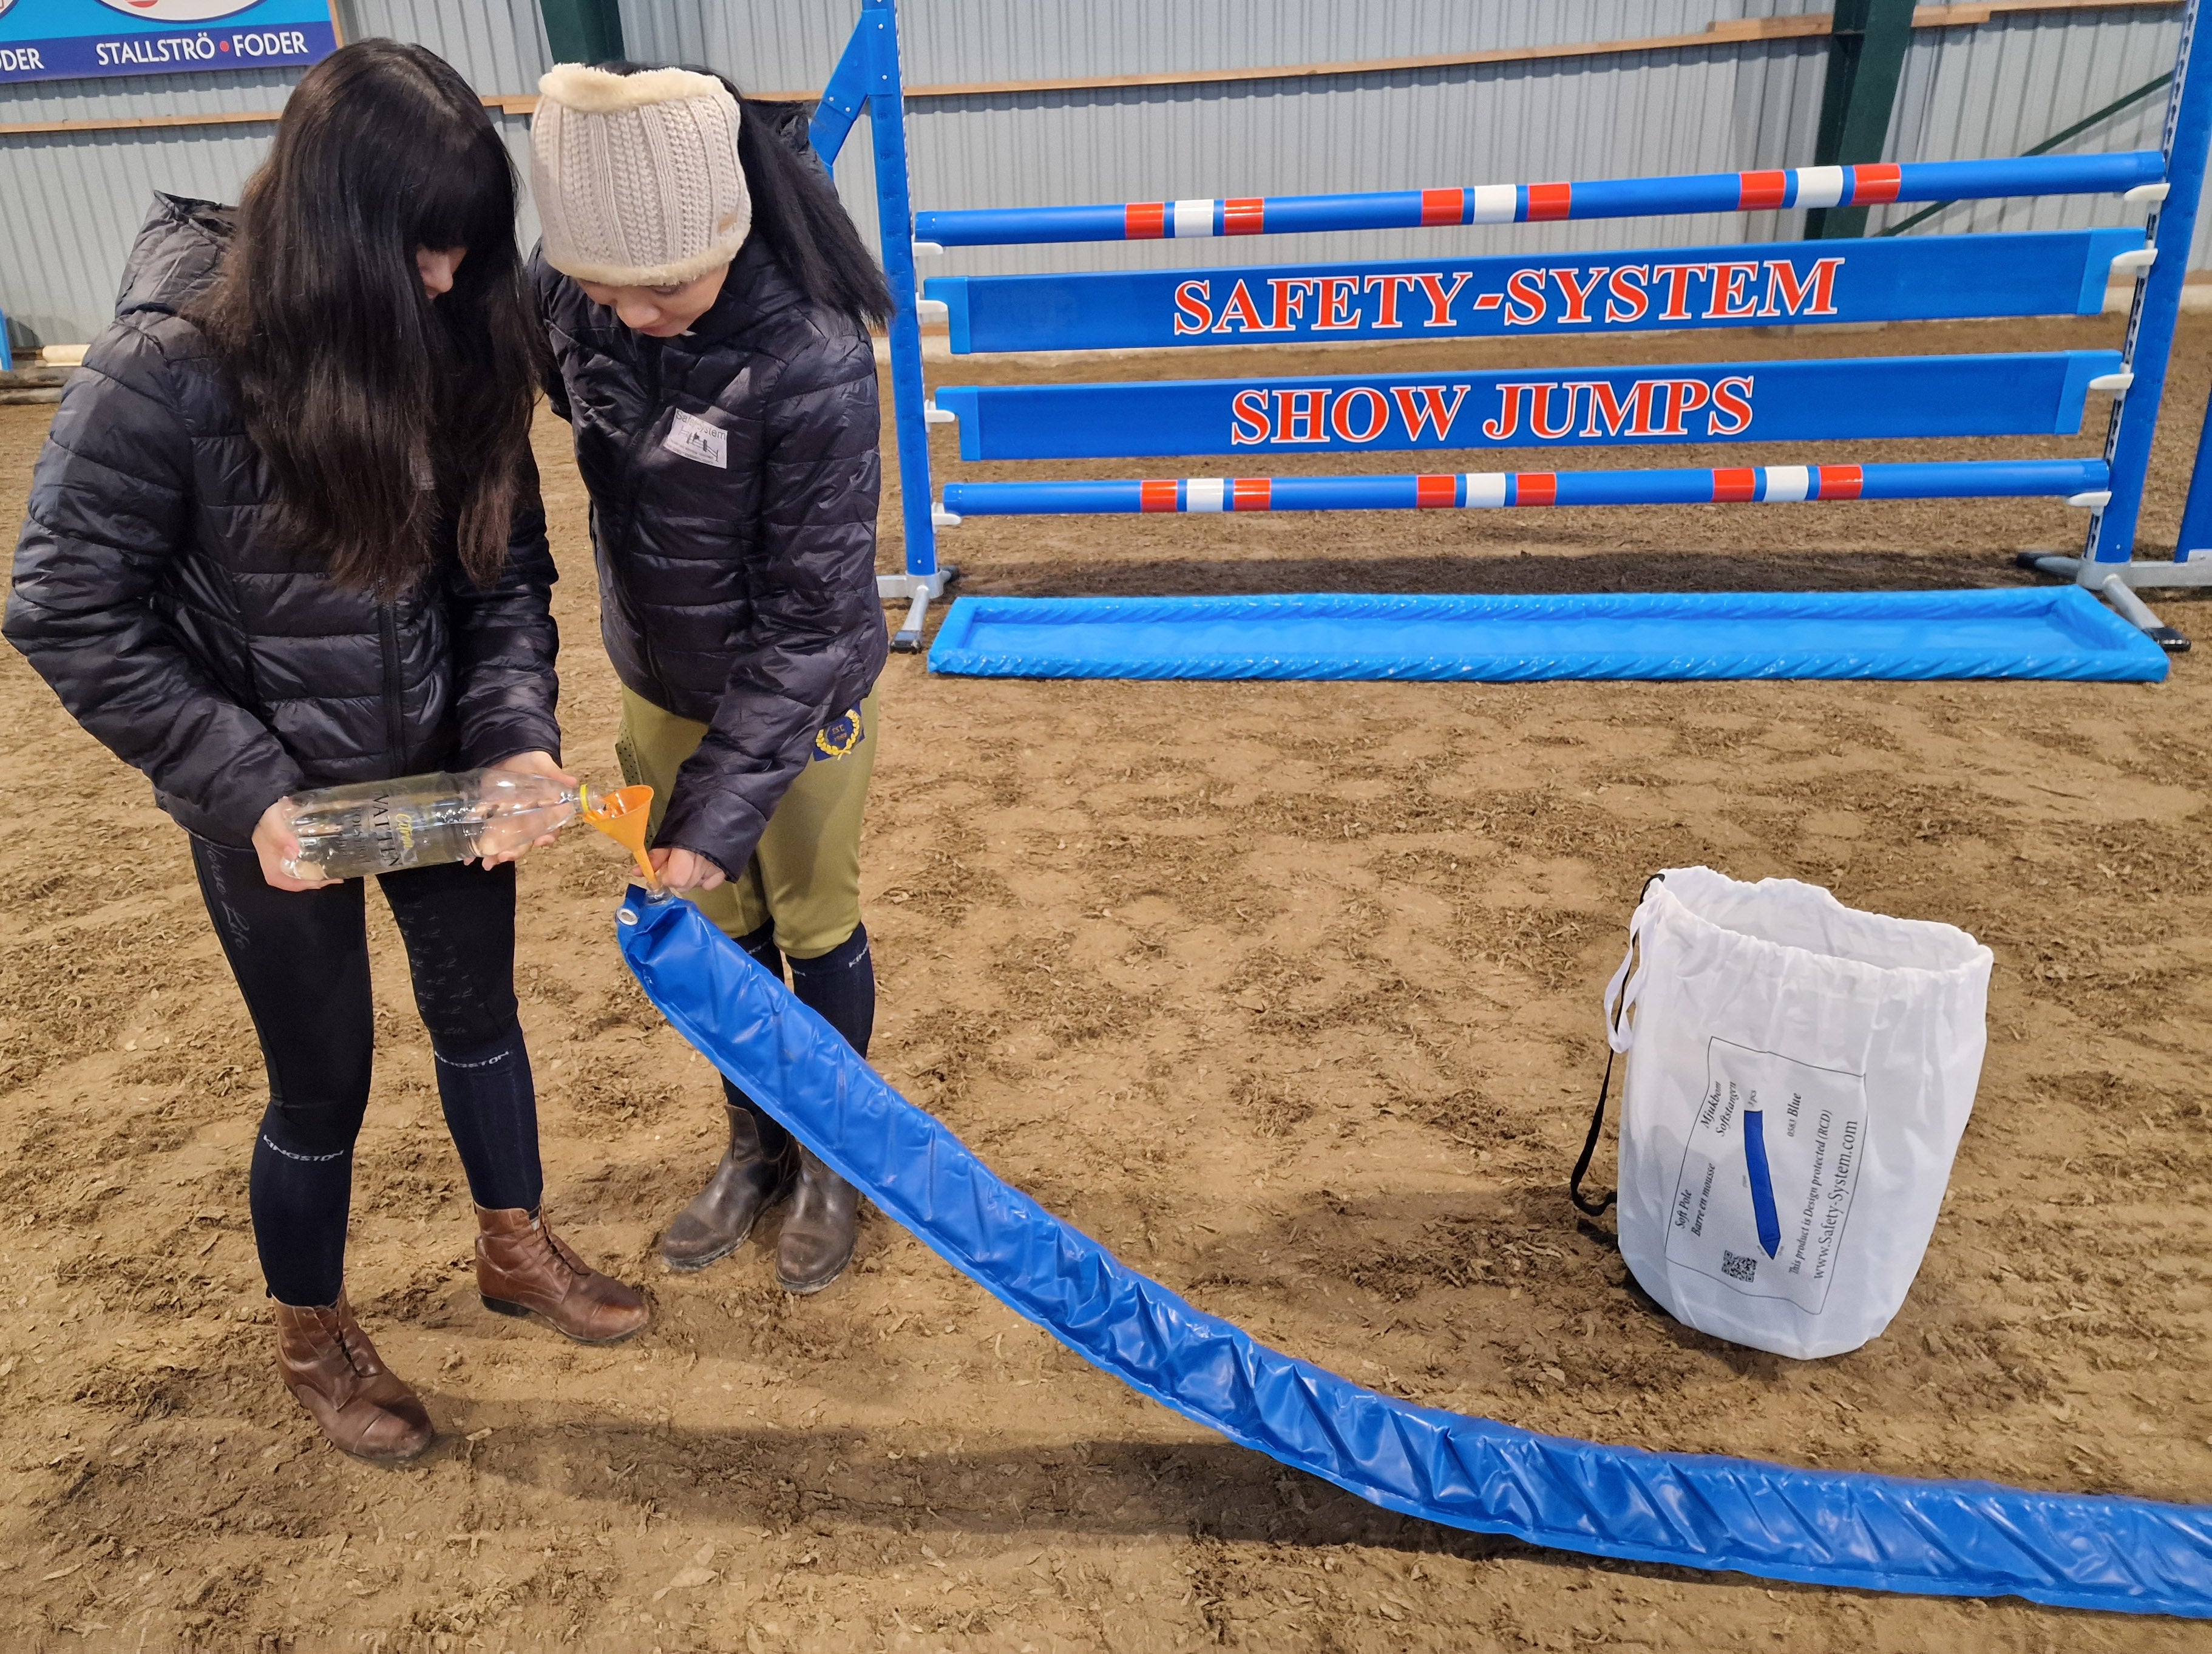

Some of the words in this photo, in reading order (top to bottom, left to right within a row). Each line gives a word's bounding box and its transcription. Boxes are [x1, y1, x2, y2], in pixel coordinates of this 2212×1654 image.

[0, 47, 45, 71] DER
[95, 32, 215, 66] STALLSTRÖ
[232, 31, 309, 58] FODER
[1174, 257, 1846, 336] SAFETY-SYSTEM
[1231, 384, 1471, 446] SHOW
[1482, 375, 1755, 440] JUMPS
[1700, 1080, 1722, 1129] Mjukbom
[1715, 1081, 1740, 1137] Softstangen
[1786, 1092, 1802, 1118] Blue
[1816, 1109, 1833, 1140] (RCD)
[1811, 1139, 1826, 1187] protected
[1701, 1163, 1715, 1198] mousse
[1678, 1189, 1692, 1210] Pole
[1699, 1197, 1707, 1211] en
[1803, 1186, 1820, 1218] Design
[1814, 1120, 1858, 1279] www.Safety-System.com
[1675, 1210, 1690, 1230] Soft
[1691, 1210, 1705, 1237] Barre
[1801, 1217, 1811, 1227] is
[1795, 1227, 1810, 1261] product
[1788, 1259, 1802, 1275] This
